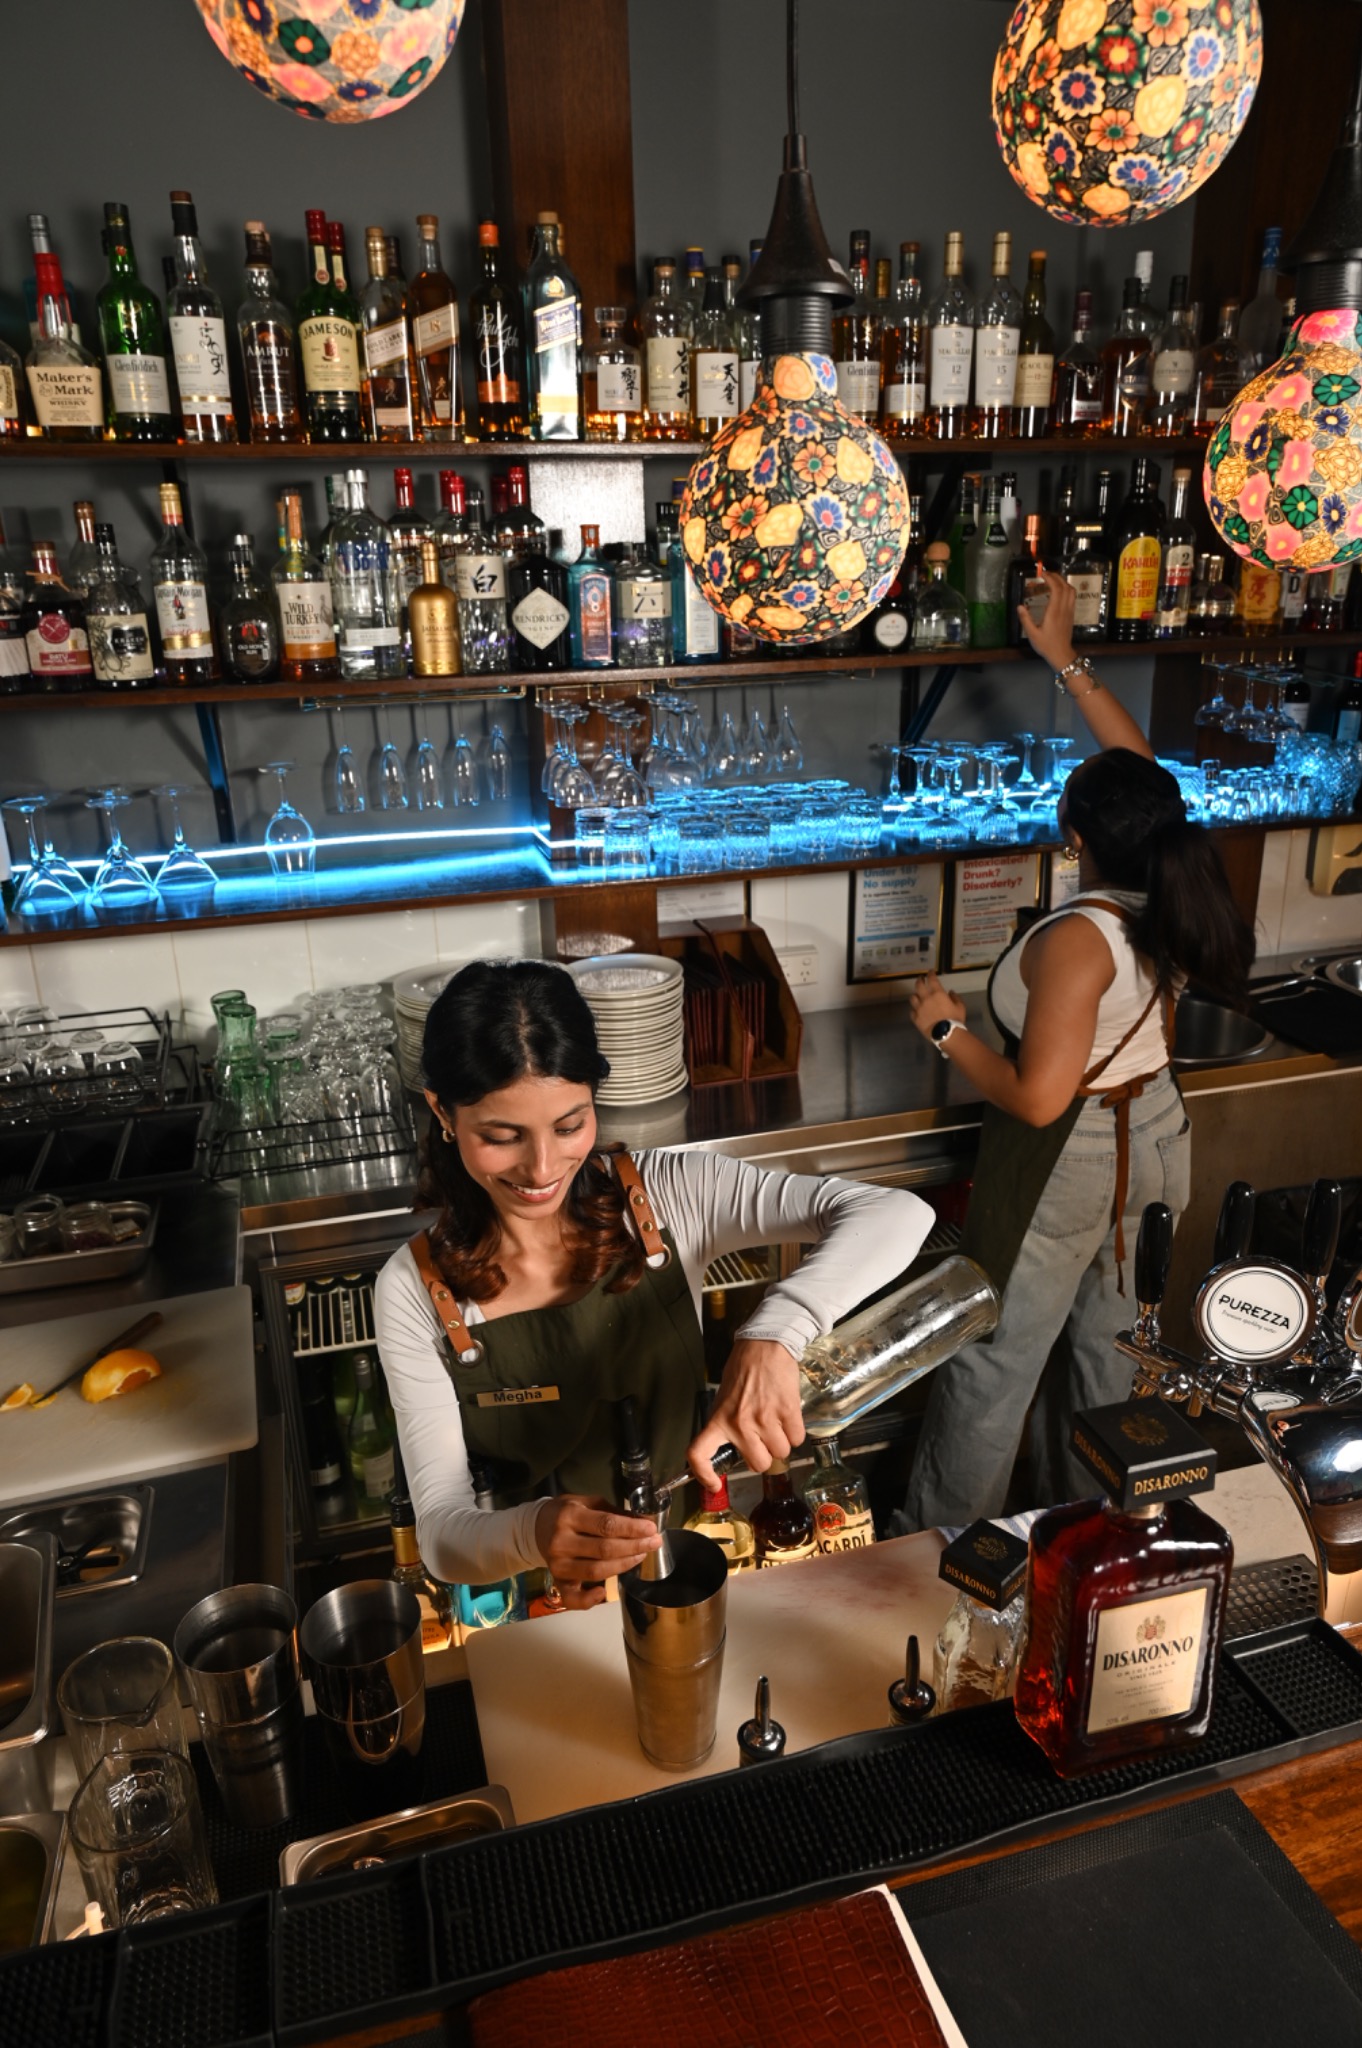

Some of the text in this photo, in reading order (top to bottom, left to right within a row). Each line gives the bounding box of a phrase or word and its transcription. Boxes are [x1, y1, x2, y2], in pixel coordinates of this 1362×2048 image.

[303, 322, 353, 340] JAMESON
[247, 346, 290, 357] AMRUT
[952, 364, 962, 374] 12
[997, 365, 1007, 375] 15
[36, 372, 93, 383] Maker's
[54, 385, 95, 396] Mark
[470, 564, 498, 595] 白
[633, 586, 664, 613] 六
[288, 602, 314, 614] WILD
[283, 612, 320, 626] TURKEY
[963, 868, 1001, 881] Drunk?
[864, 876, 917, 889] No supply
[962, 876, 1023, 892] Disorderly?
[1219, 1294, 1290, 1330] PUREZZA
[493, 1390, 543, 1403] Megha
[1133, 1466, 1208, 1496] DISARONNO
[944, 1563, 997, 1600] DISARONNO
[1102, 1636, 1194, 1671] DISARONNO
[1116, 1661, 1177, 1678] ORIGINALE
